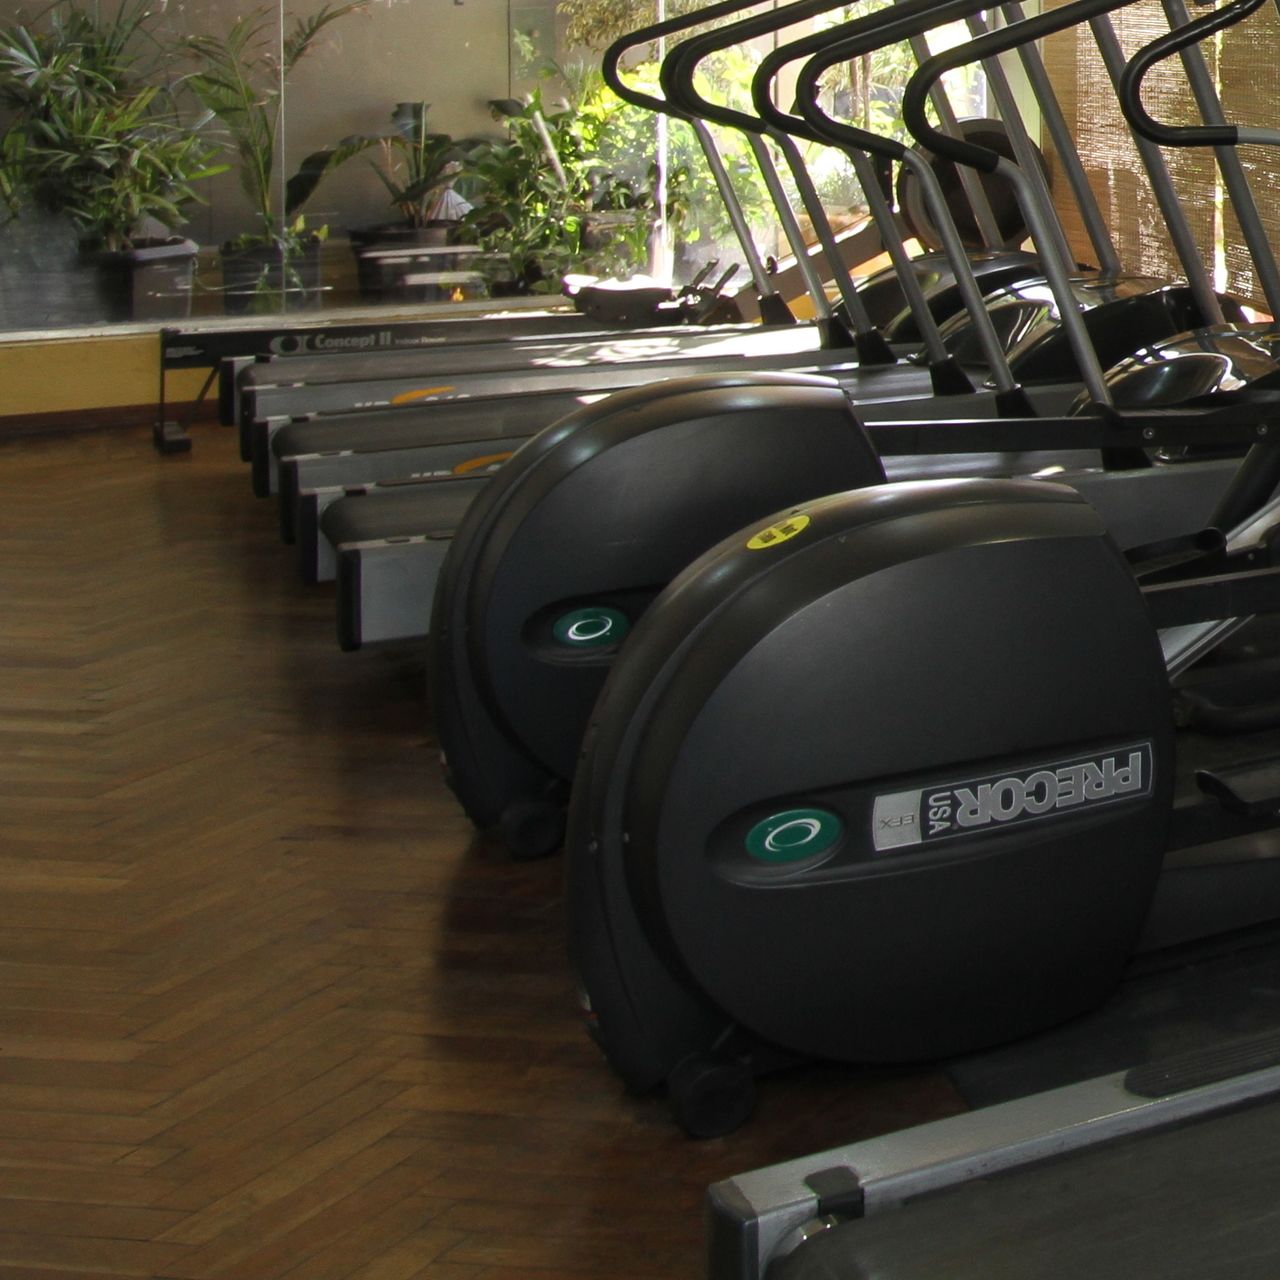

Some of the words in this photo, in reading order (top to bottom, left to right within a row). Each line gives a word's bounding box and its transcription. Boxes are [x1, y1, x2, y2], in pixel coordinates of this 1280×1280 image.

[314, 333, 376, 349] Concept
[954, 751, 1142, 828] PRECOR
[881, 811, 915, 830] EFX
[928, 791, 951, 835] USA
